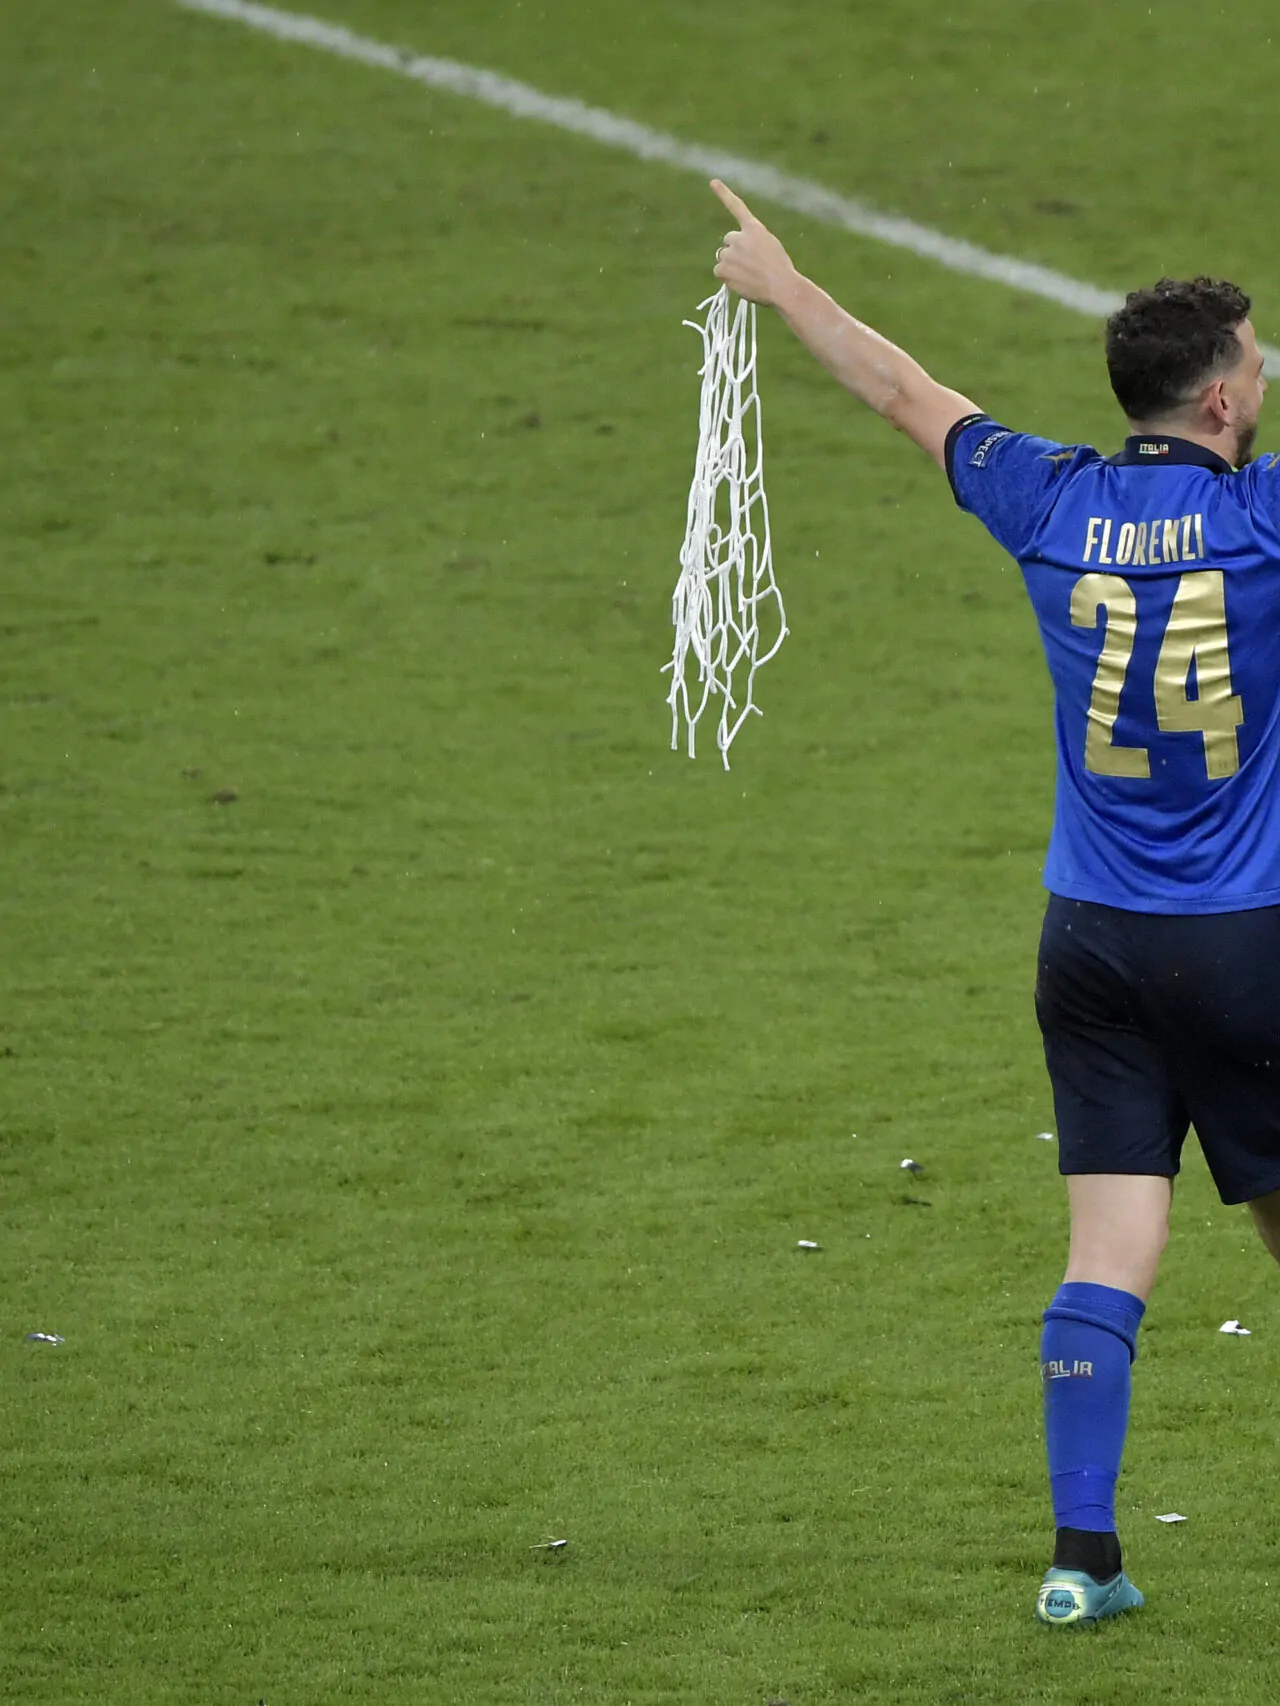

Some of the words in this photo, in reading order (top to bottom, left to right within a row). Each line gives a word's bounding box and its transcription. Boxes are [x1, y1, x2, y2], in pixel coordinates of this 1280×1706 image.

[1139, 443, 1169, 452] ITALIA
[1082, 513, 1204, 565] FLORENZI
[1070, 570, 1244, 780] 24
